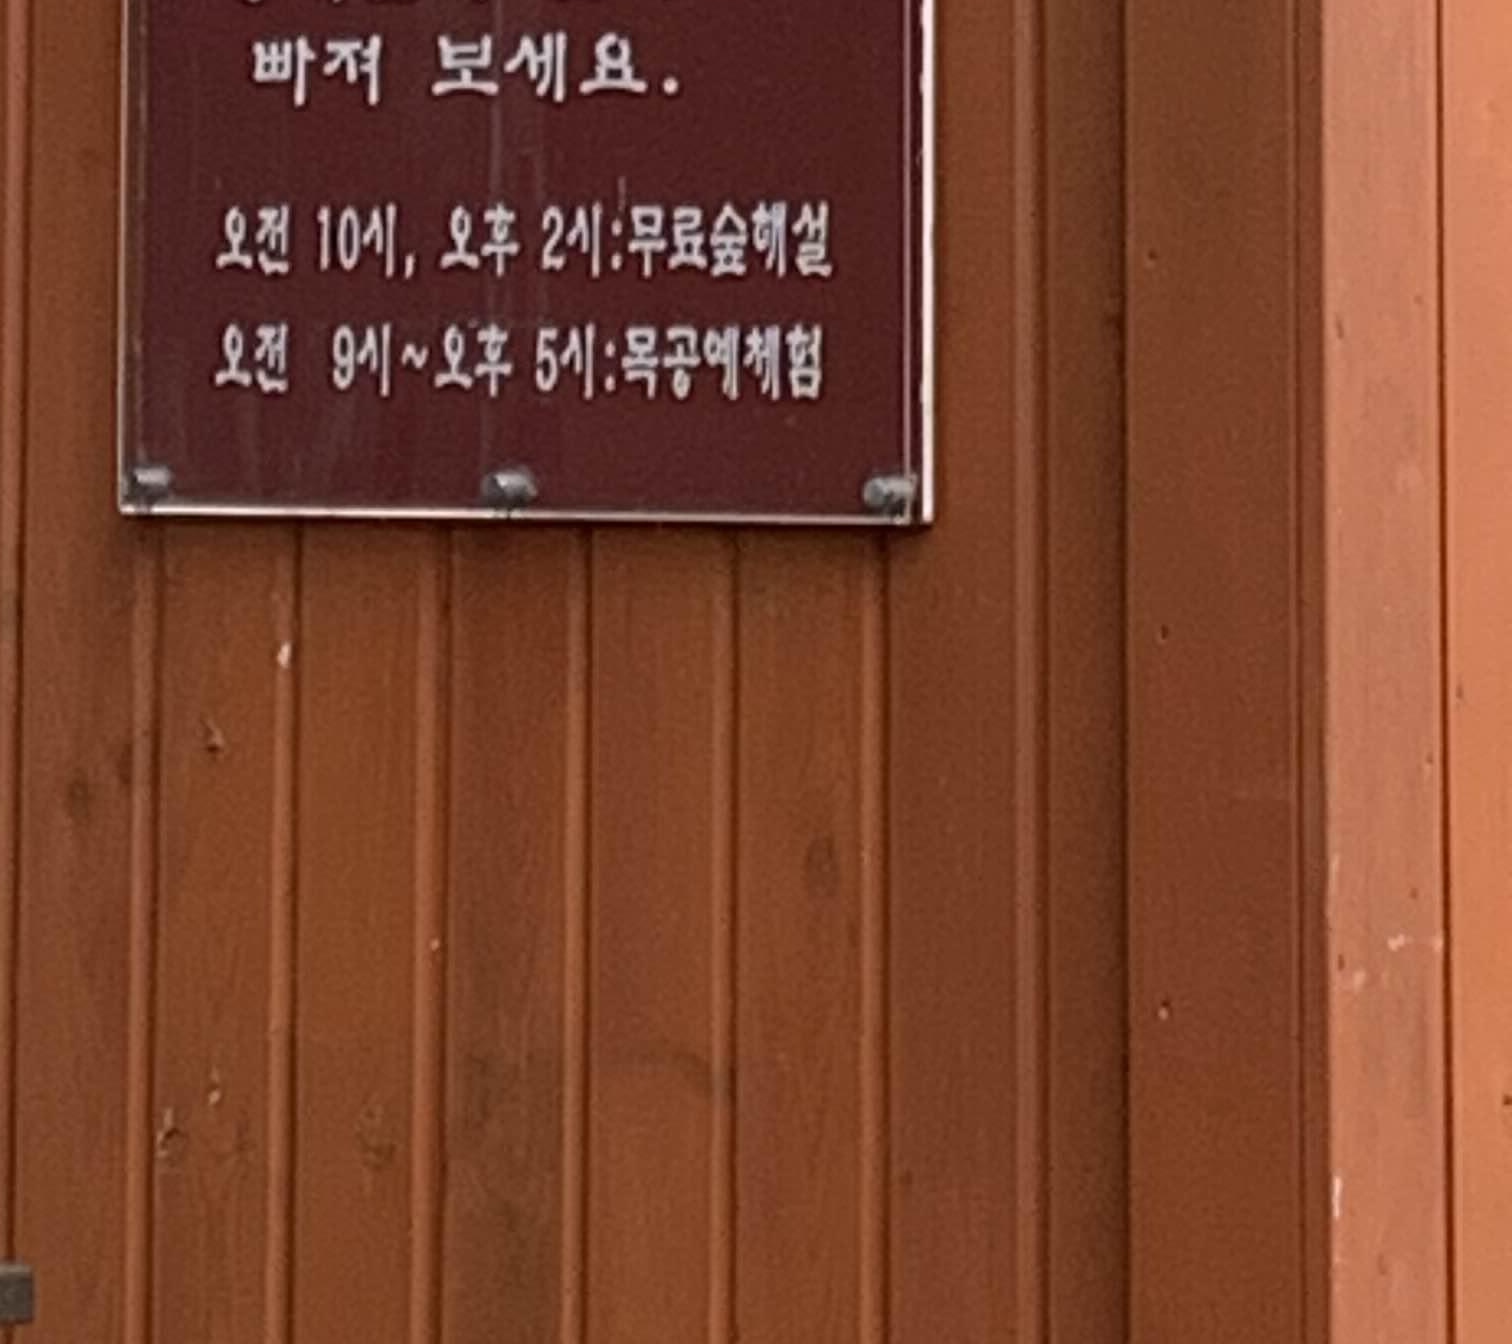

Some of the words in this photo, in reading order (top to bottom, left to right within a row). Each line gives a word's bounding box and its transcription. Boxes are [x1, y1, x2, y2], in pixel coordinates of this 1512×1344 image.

[252, 34, 382, 107] 빠져
[431, 31, 679, 103] 보세요.
[215, 204, 290, 275] 오전
[317, 202, 415, 279] 10시,
[440, 202, 520, 277] 오후
[215, 323, 289, 393] 오전
